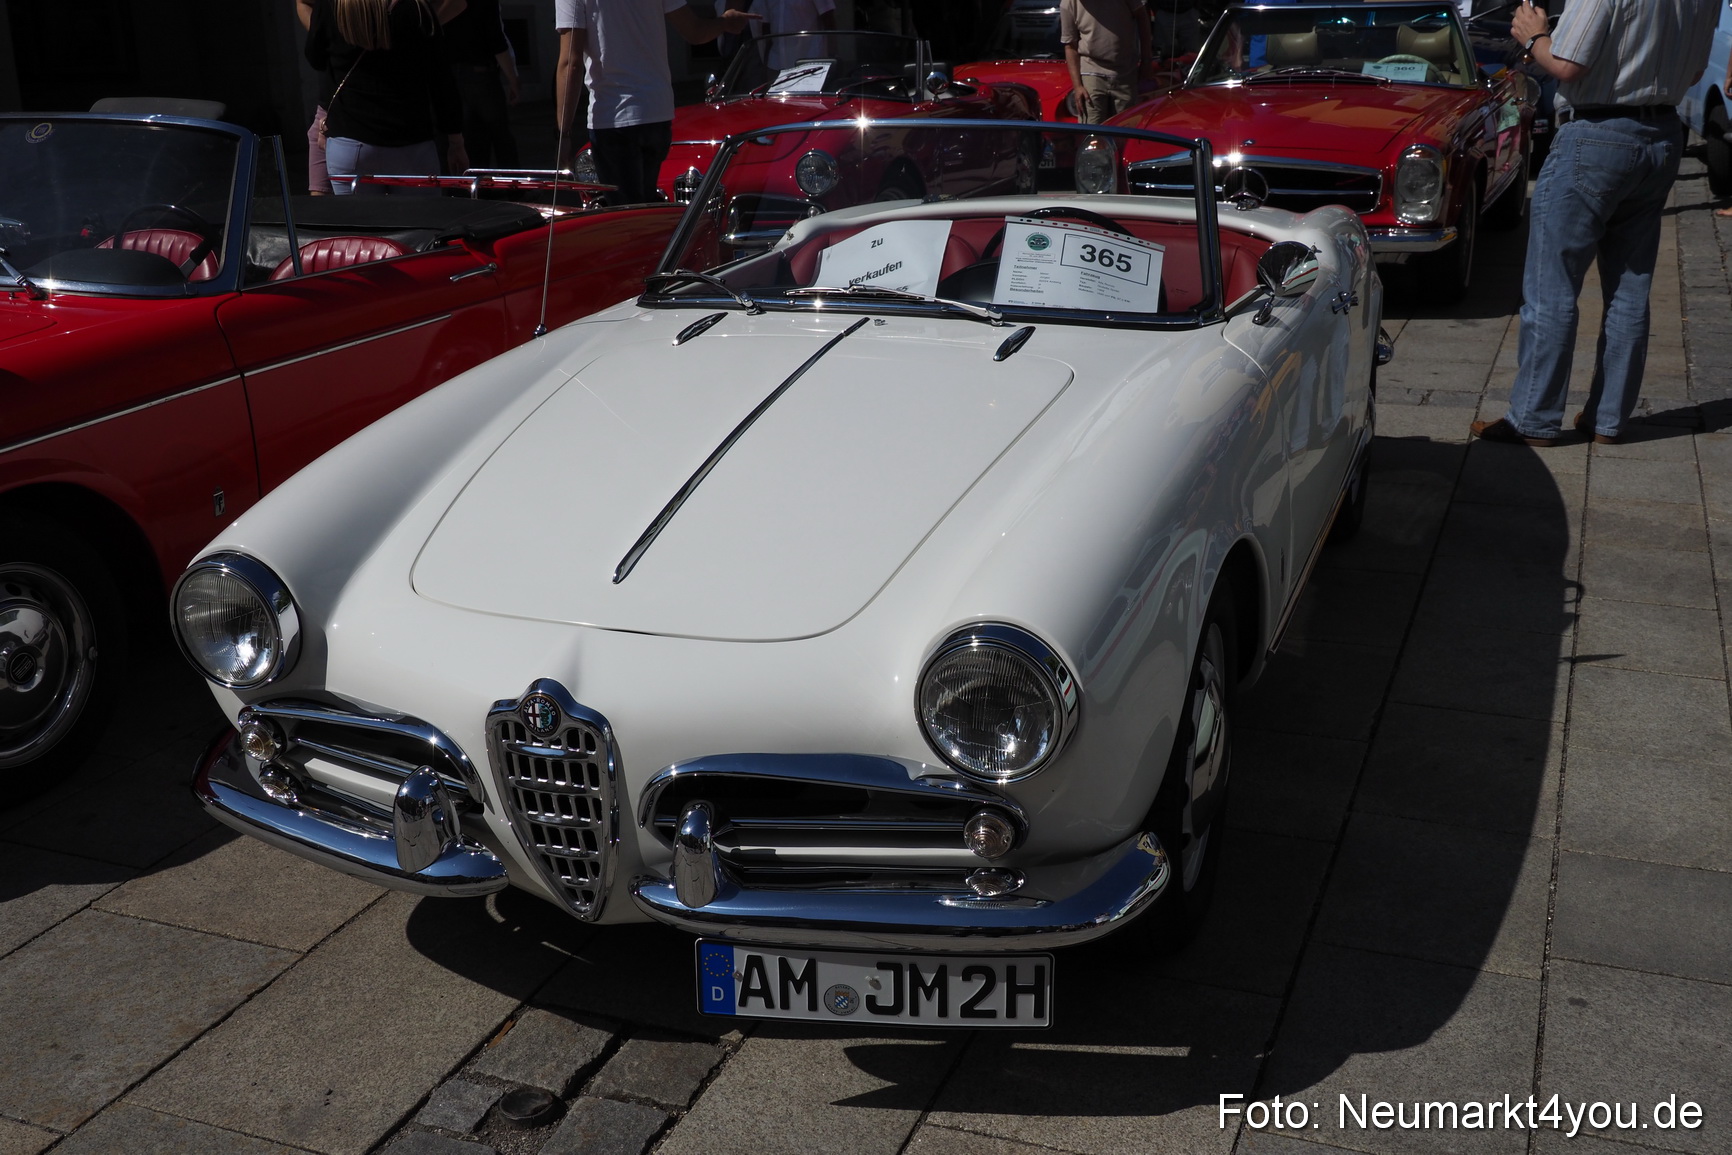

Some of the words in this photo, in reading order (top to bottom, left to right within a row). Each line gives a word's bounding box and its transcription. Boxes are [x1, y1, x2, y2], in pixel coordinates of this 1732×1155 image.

[871, 238, 884, 249] zu
[1079, 244, 1132, 273] 365
[848, 261, 903, 285] verkaufen
[711, 986, 725, 1001] D
[738, 954, 818, 1011] AM
[865, 962, 1046, 1018] JM2H
